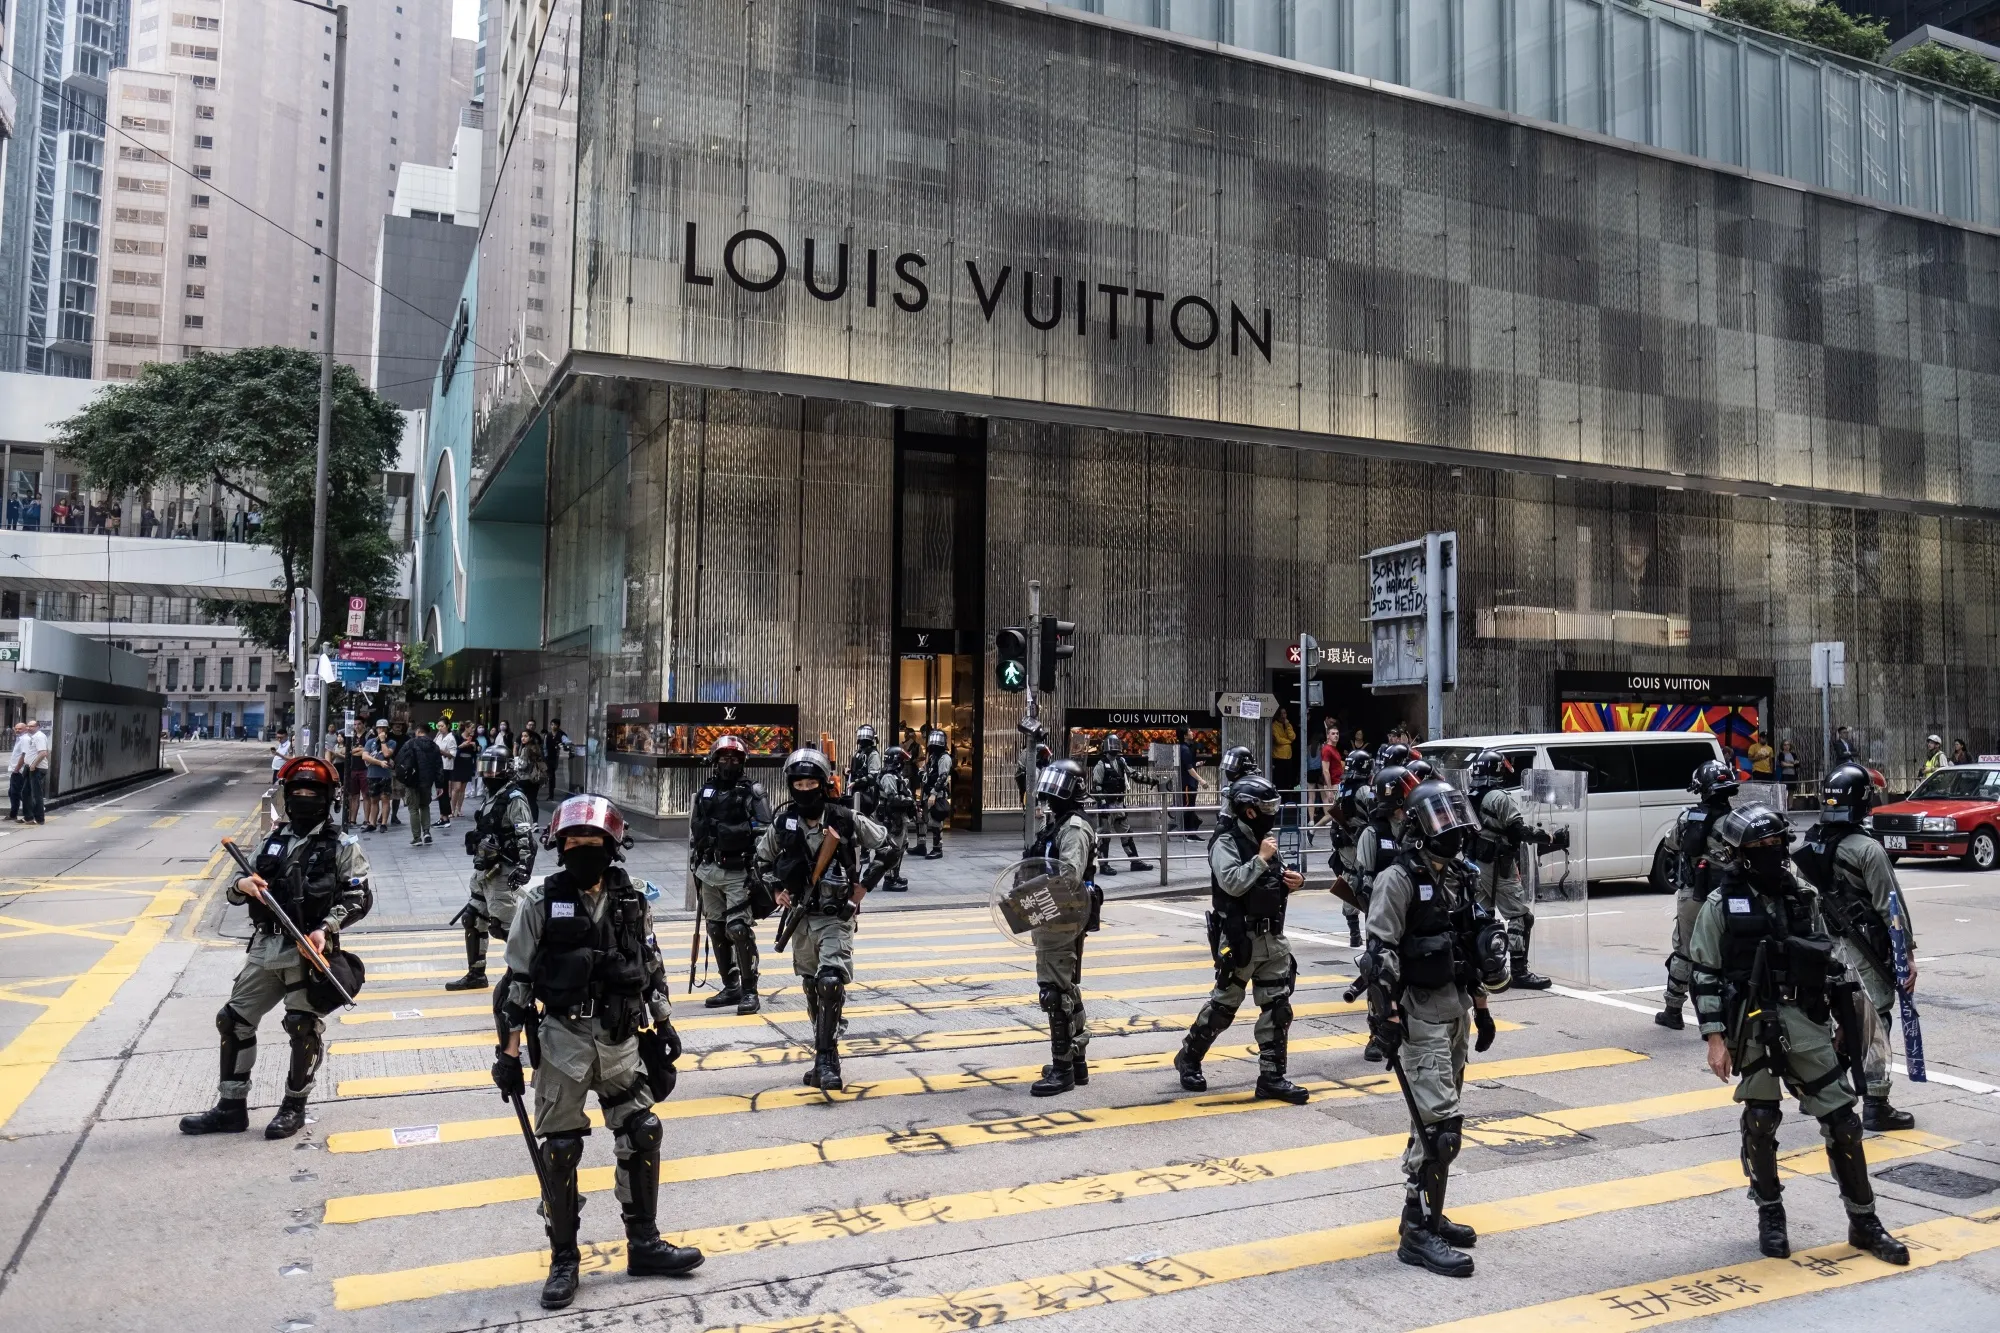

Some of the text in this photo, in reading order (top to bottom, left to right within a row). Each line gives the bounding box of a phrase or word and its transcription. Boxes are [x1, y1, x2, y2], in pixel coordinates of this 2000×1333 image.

[685, 221, 1272, 364] LOUIS VUITTON
[1373, 559, 1406, 583] SORRY
[1371, 586, 1382, 601] NO
[1372, 600, 1392, 614] JUST
[1628, 677, 1710, 690] LOUIS VUITTON
[1108, 713, 1188, 724] LOUIS VUITTON
[1750, 819, 1770, 828] Police
[1033, 887, 1061, 921] POLICE
[1600, 1274, 1763, 1320] 五大訴求
